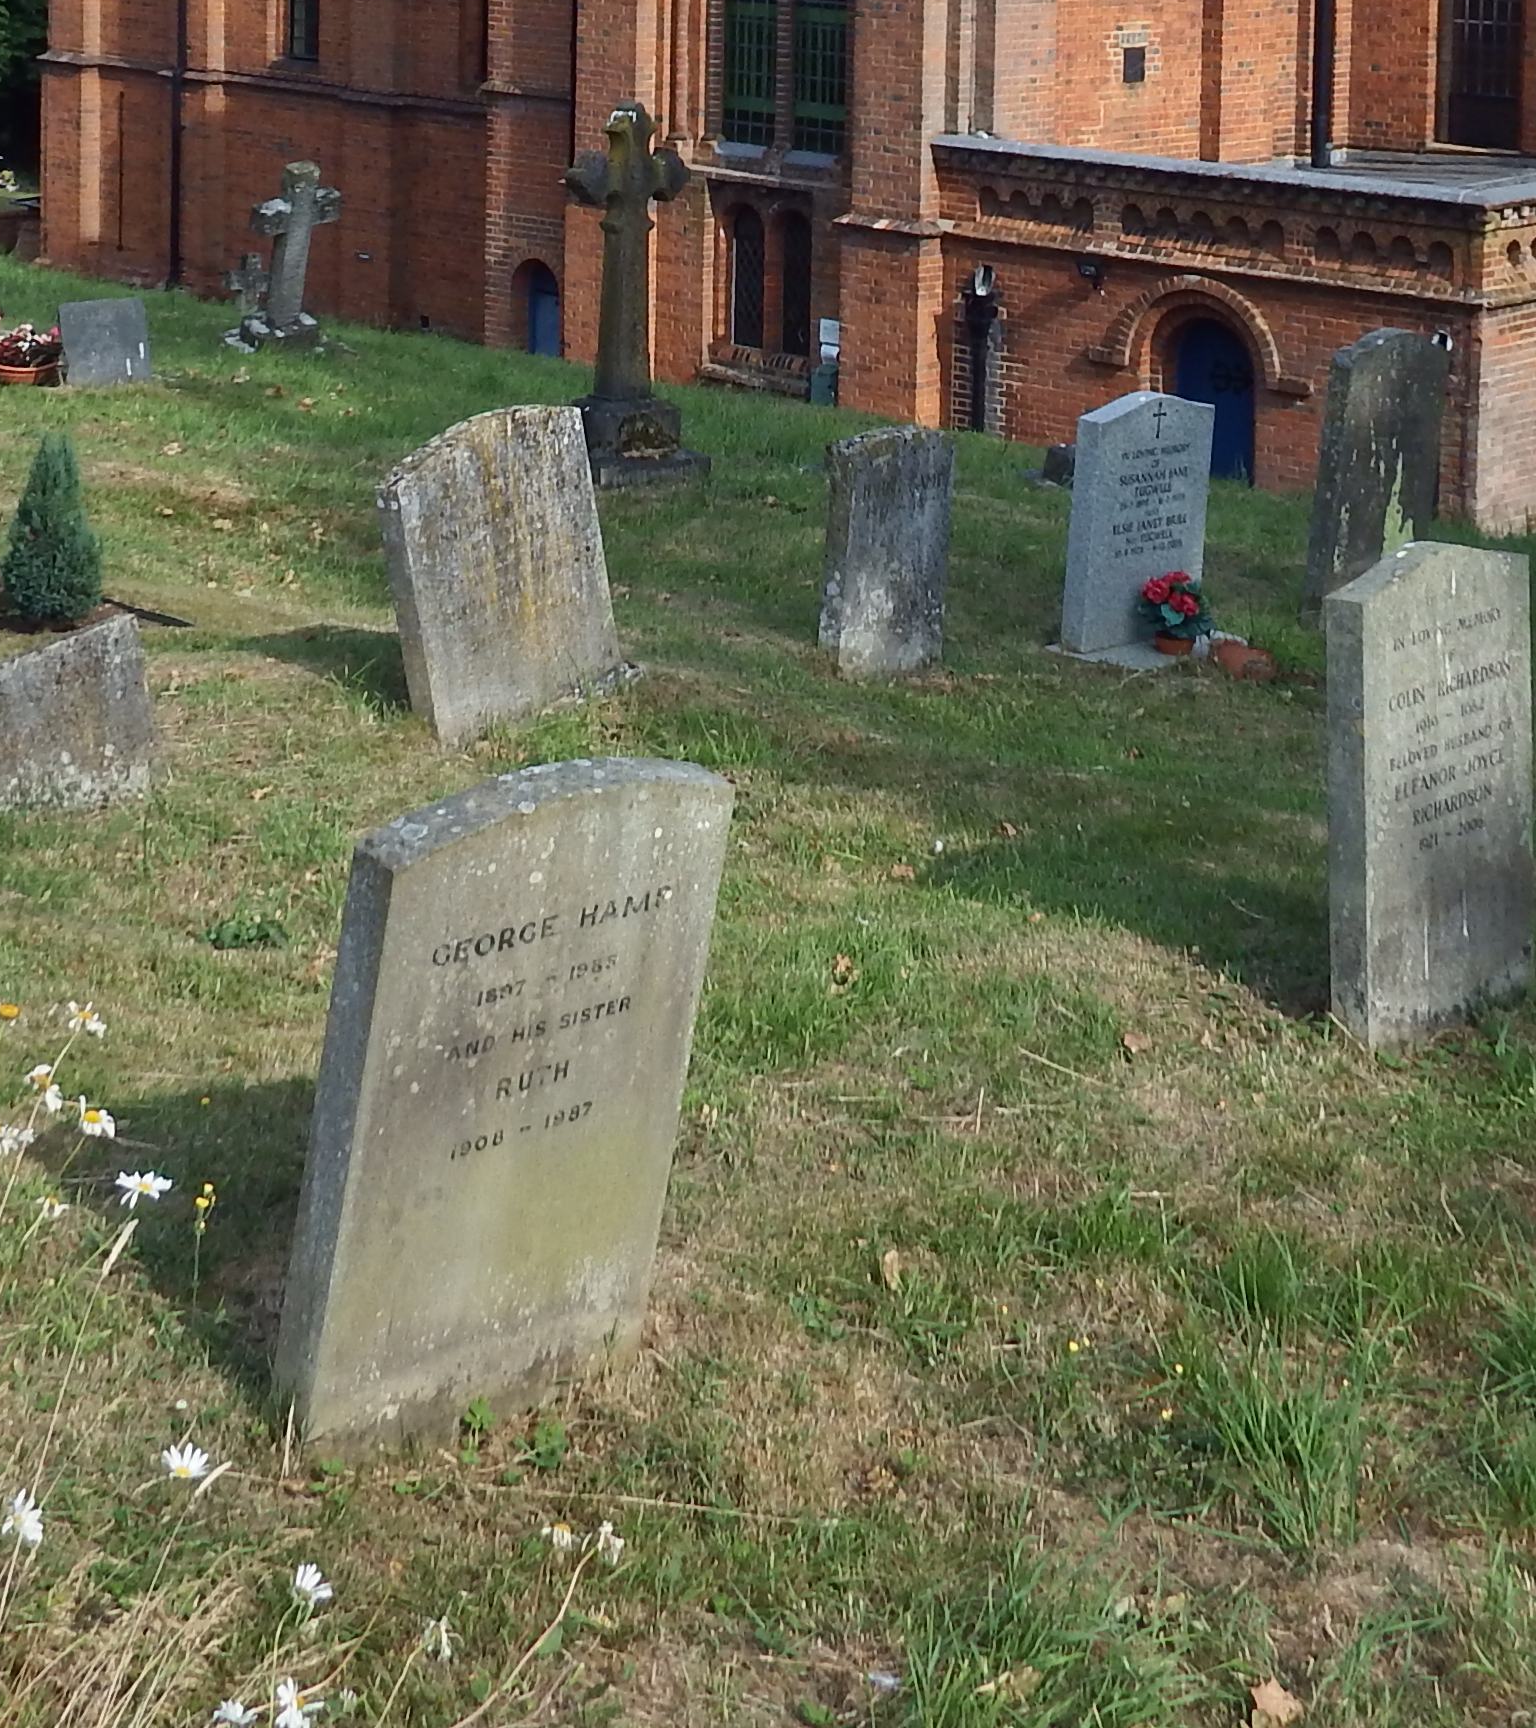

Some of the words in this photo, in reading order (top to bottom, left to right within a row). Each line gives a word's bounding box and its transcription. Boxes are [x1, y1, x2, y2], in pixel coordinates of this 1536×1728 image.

[1388, 685, 1426, 713] COLIN
[1437, 657, 1511, 698] RICHARDSON
[1394, 765, 1457, 803] ELEANOR
[1463, 749, 1505, 777] JOYCE
[1412, 784, 1493, 827] RICHARDSON
[432, 914, 560, 967] GEORGE
[445, 1034, 497, 1063] AND
[511, 1019, 547, 1045] HIS
[558, 994, 632, 1030] SISTER
[495, 1058, 570, 1101] RUTH
[449, 1128, 505, 1162] 1908
[544, 1100, 594, 1130] 1987
